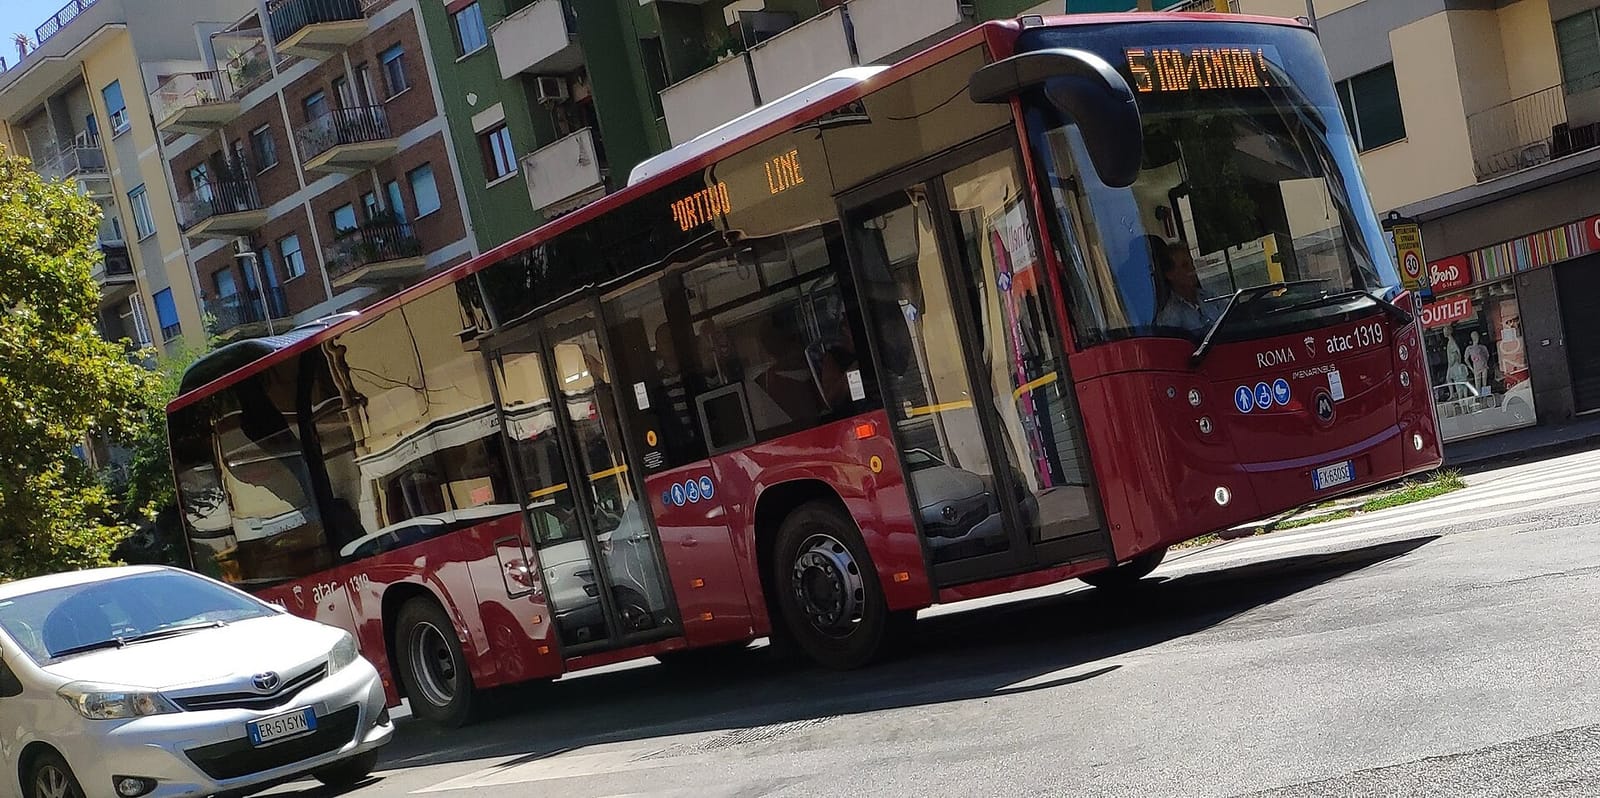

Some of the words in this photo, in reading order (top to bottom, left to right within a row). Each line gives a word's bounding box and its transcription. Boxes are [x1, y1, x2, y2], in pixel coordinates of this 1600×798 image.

[1127, 48, 1153, 92] 5
[764, 149, 804, 194] LINE
[1406, 258, 1417, 271] 30
[1420, 299, 1468, 325] OUTLET
[1256, 347, 1296, 369] ROMA
[1326, 335, 1354, 354] atac
[1353, 322, 1383, 348] 1319
